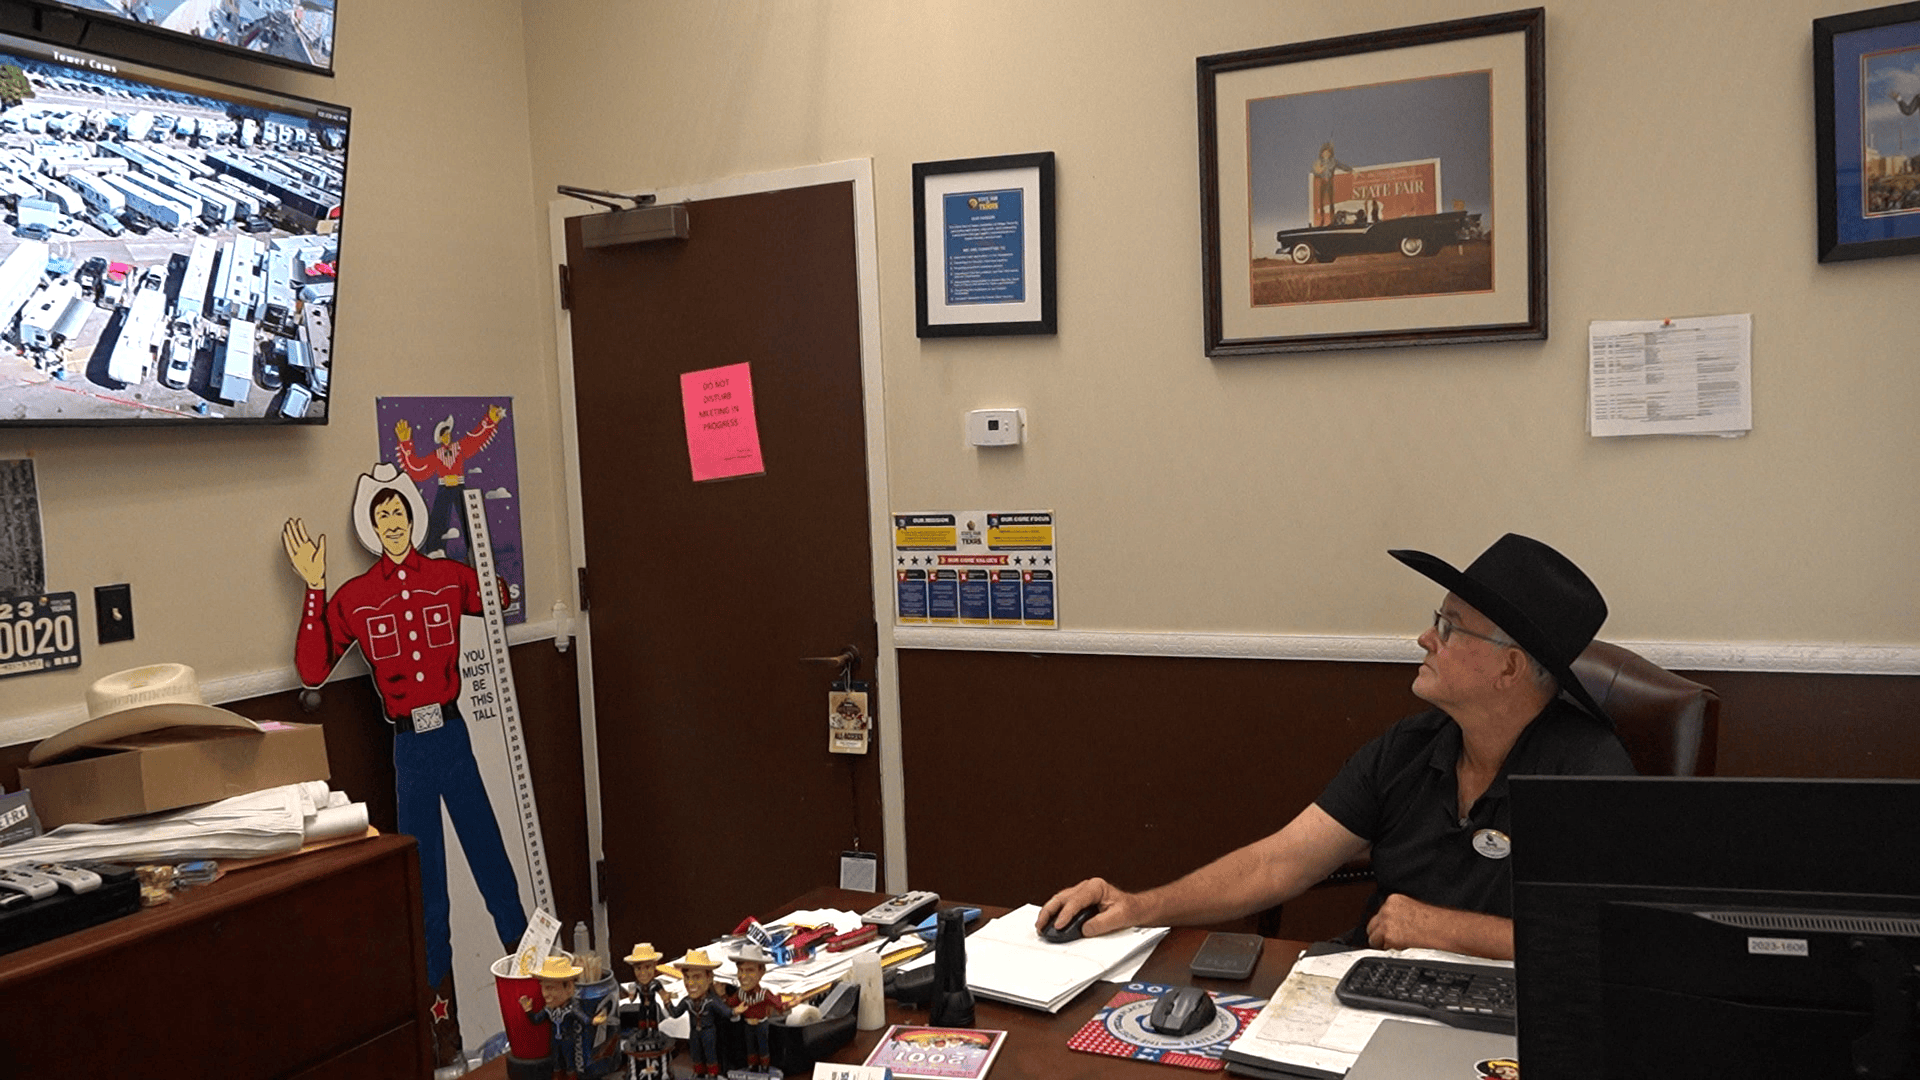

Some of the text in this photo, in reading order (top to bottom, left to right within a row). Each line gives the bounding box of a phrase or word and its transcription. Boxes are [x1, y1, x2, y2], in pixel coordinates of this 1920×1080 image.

[53, 50, 118, 74] Tower Cams
[1352, 179, 1425, 200] STATE FAIR
[703, 378, 730, 391] DO NOT
[698, 406, 731, 418] MEETING
[703, 418, 739, 431] PROGRESS
[1030, 515, 1050, 523] FOCUS
[961, 538, 983, 546] TEXAS
[991, 573, 998, 581] A
[463, 649, 486, 664] YOU
[462, 662, 492, 680] MUST
[472, 676, 487, 692] BE
[470, 692, 495, 710] THIS
[472, 708, 498, 723] TALL
[894, 1051, 967, 1065] 2001
